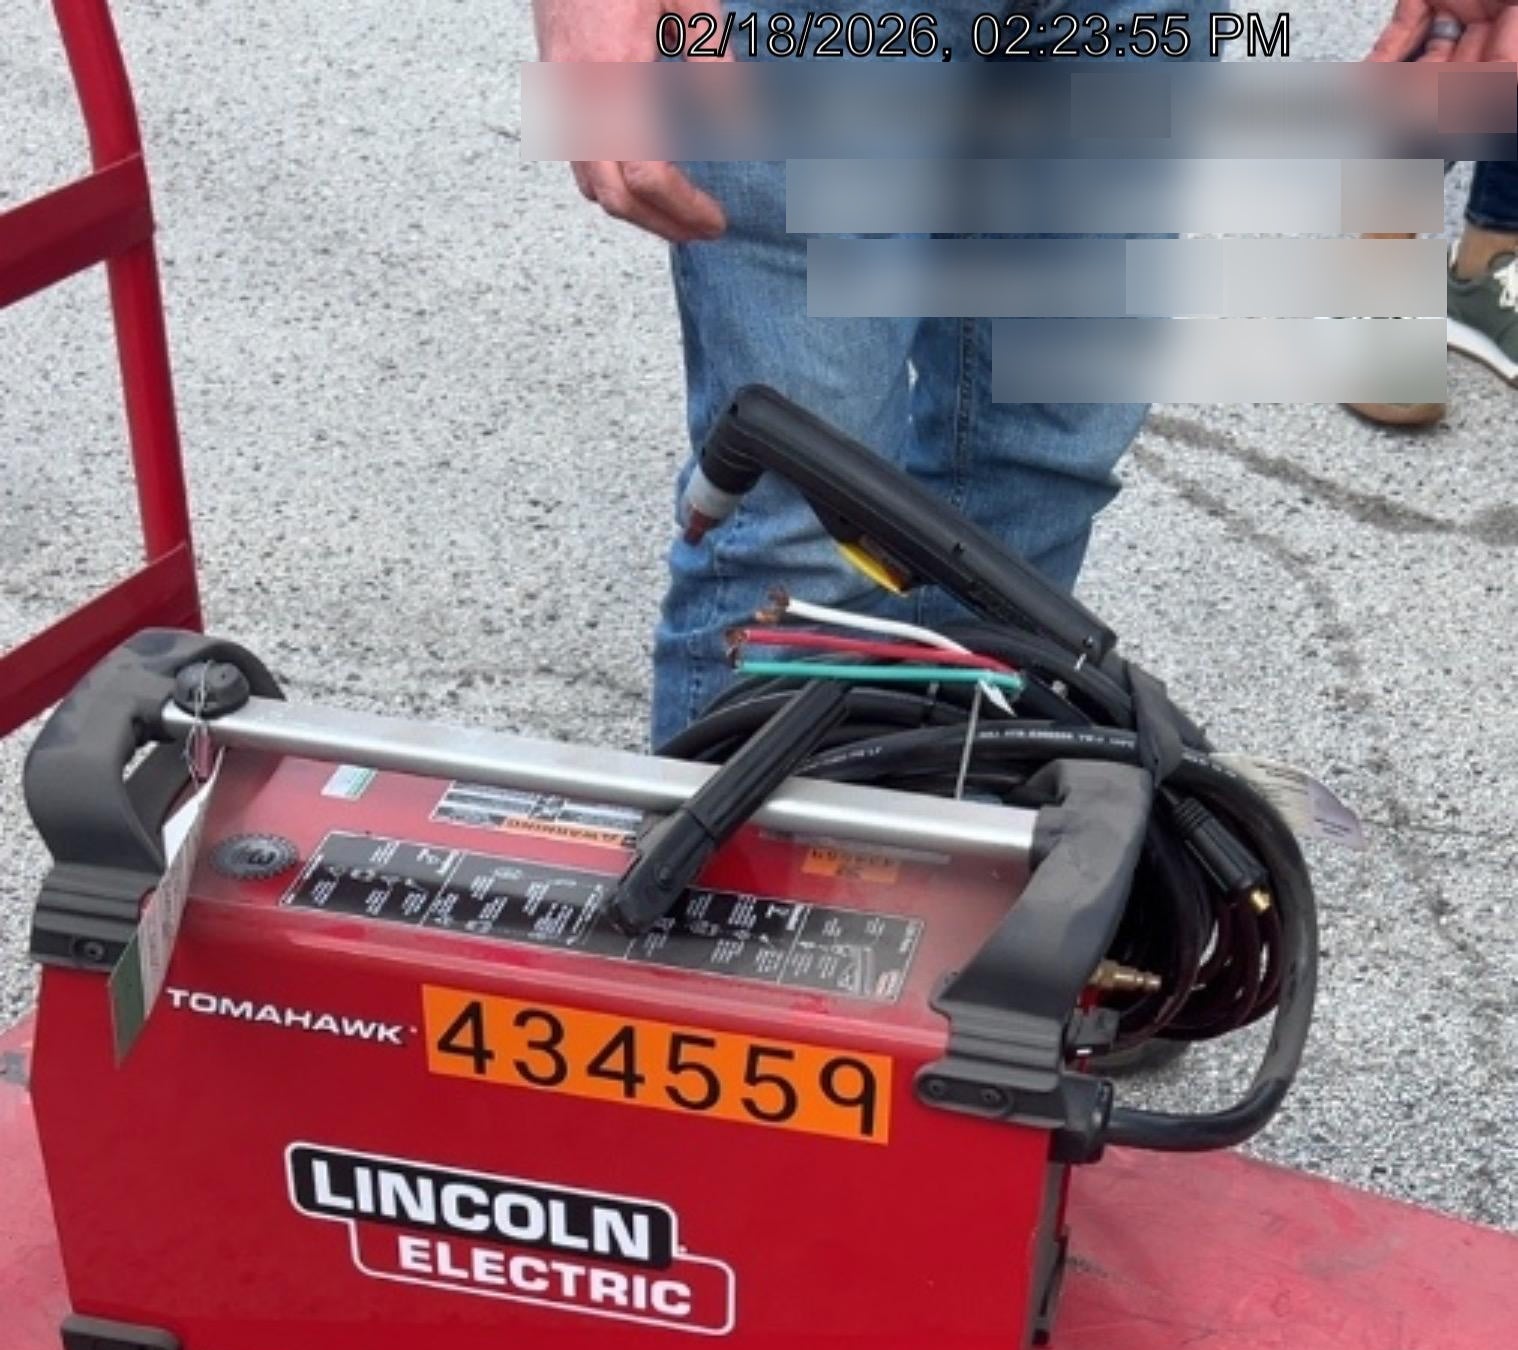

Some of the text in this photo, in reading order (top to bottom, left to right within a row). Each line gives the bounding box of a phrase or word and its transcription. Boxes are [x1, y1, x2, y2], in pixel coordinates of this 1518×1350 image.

[166, 986, 403, 1044] TOMAHAWK
[437, 1001, 877, 1136] 434559
[311, 1159, 651, 1262] LINCOLN
[398, 1235, 692, 1317] ELECTRIC
